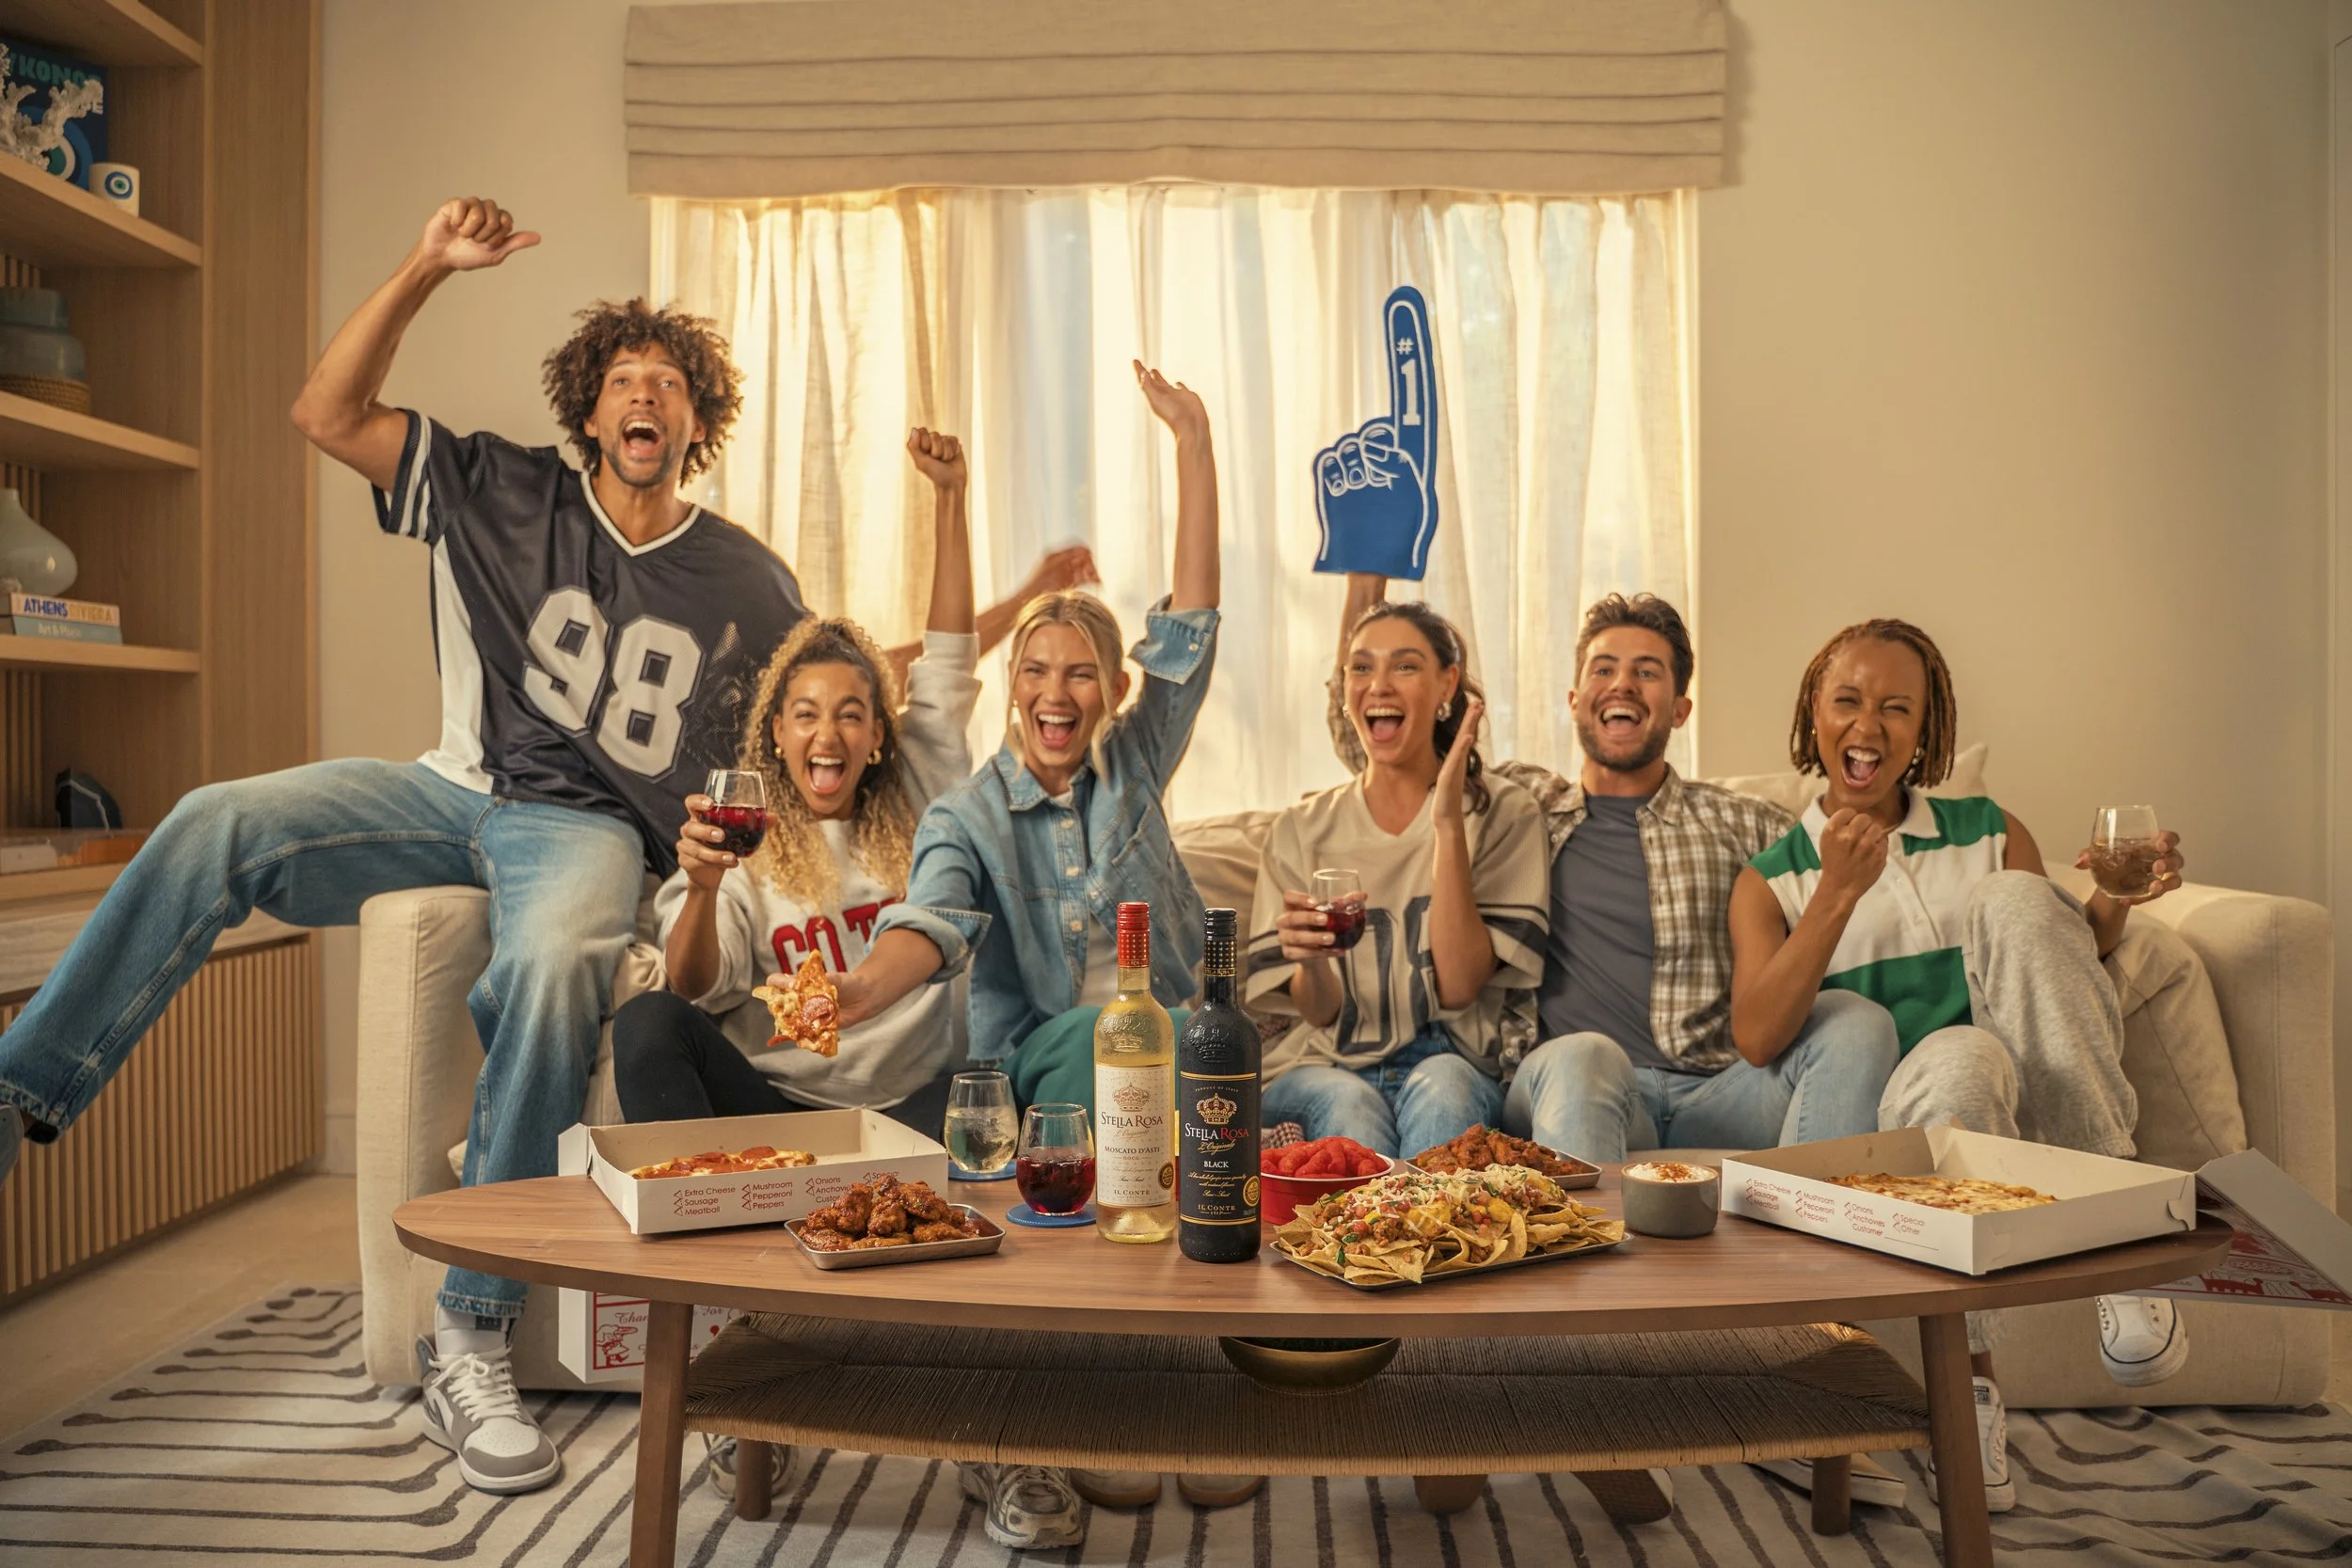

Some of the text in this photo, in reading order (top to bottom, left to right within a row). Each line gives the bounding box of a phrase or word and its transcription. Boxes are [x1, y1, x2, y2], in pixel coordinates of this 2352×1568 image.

[24, 597, 69, 617] ATHENS
[523, 587, 705, 781] 98
[772, 893, 906, 974] COT
[1104, 1146, 1136, 1154] MOSCATO
[753, 1181, 793, 1191] Mushroom
[1754, 1180, 1791, 1196] Extra Cheese
[684, 1189, 704, 1197] Extra
[753, 1190, 793, 1201] Pepperoni
[1754, 1189, 1778, 1202] Sausage
[1804, 1193, 1835, 1205] Mushroom
[684, 1197, 719, 1206] Sausage
[753, 1200, 785, 1211] Peppers
[1754, 1199, 1780, 1211] Meatball
[1804, 1201, 1835, 1214] Pepperoni
[685, 1206, 721, 1215] Meatball
[1851, 1204, 1874, 1214] Onions
[1852, 1214, 1885, 1227] Anchovies
[1852, 1223, 1883, 1236] Customer
[1900, 1225, 1920, 1234] Other
